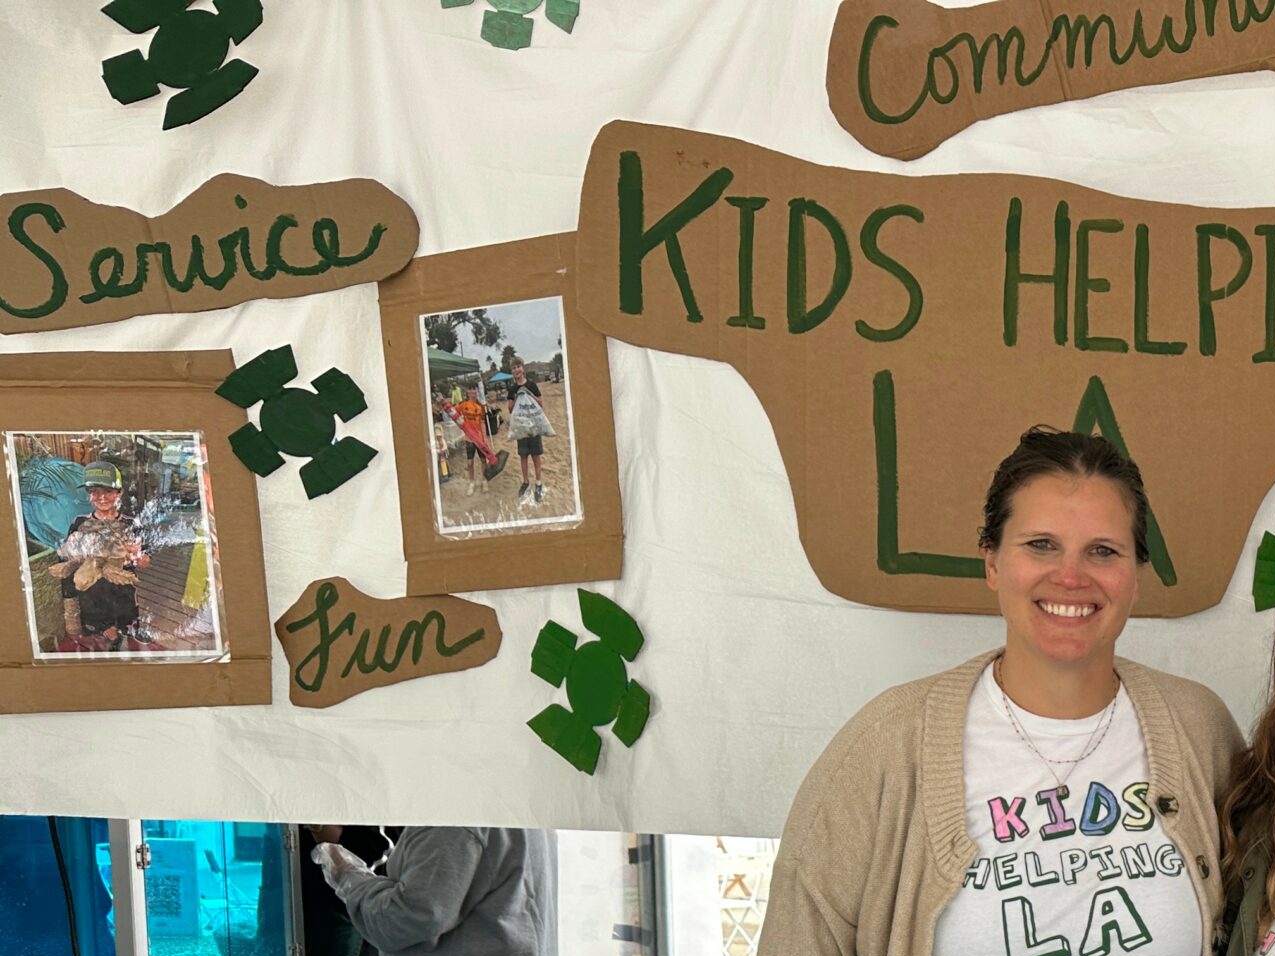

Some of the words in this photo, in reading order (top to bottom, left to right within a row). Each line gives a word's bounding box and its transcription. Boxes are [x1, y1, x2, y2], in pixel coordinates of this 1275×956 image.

[0, 195, 388, 318] Service
[617, 150, 925, 343] KIDS
[286, 582, 485, 692] Fun
[962, 843, 1185, 890] HELPING
[987, 781, 1154, 843] KIDS
